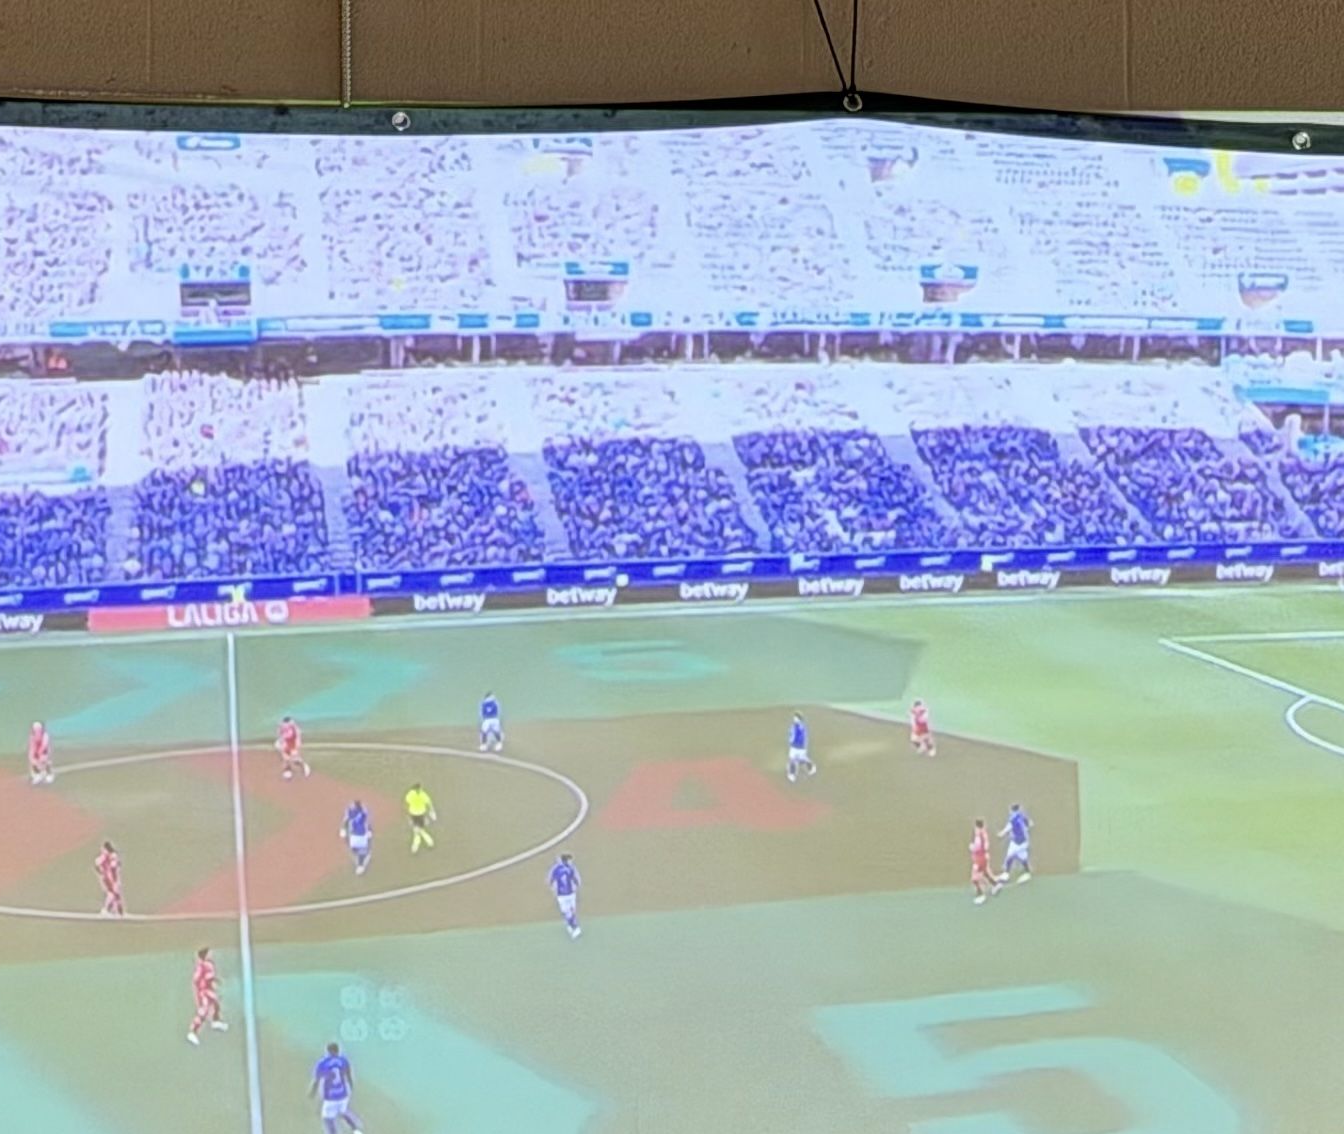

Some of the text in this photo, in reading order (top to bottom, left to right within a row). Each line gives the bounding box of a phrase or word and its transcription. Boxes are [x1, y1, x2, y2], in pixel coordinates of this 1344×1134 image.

[899, 572, 963, 592] betway
[997, 570, 1060, 589] betway
[1111, 565, 1171, 585] betway
[1216, 562, 1274, 582] betway
[680, 581, 749, 602] betway
[799, 576, 864, 597] betway
[413, 592, 486, 614] betway
[546, 588, 617, 607] betway
[167, 602, 258, 629] LALIGA
